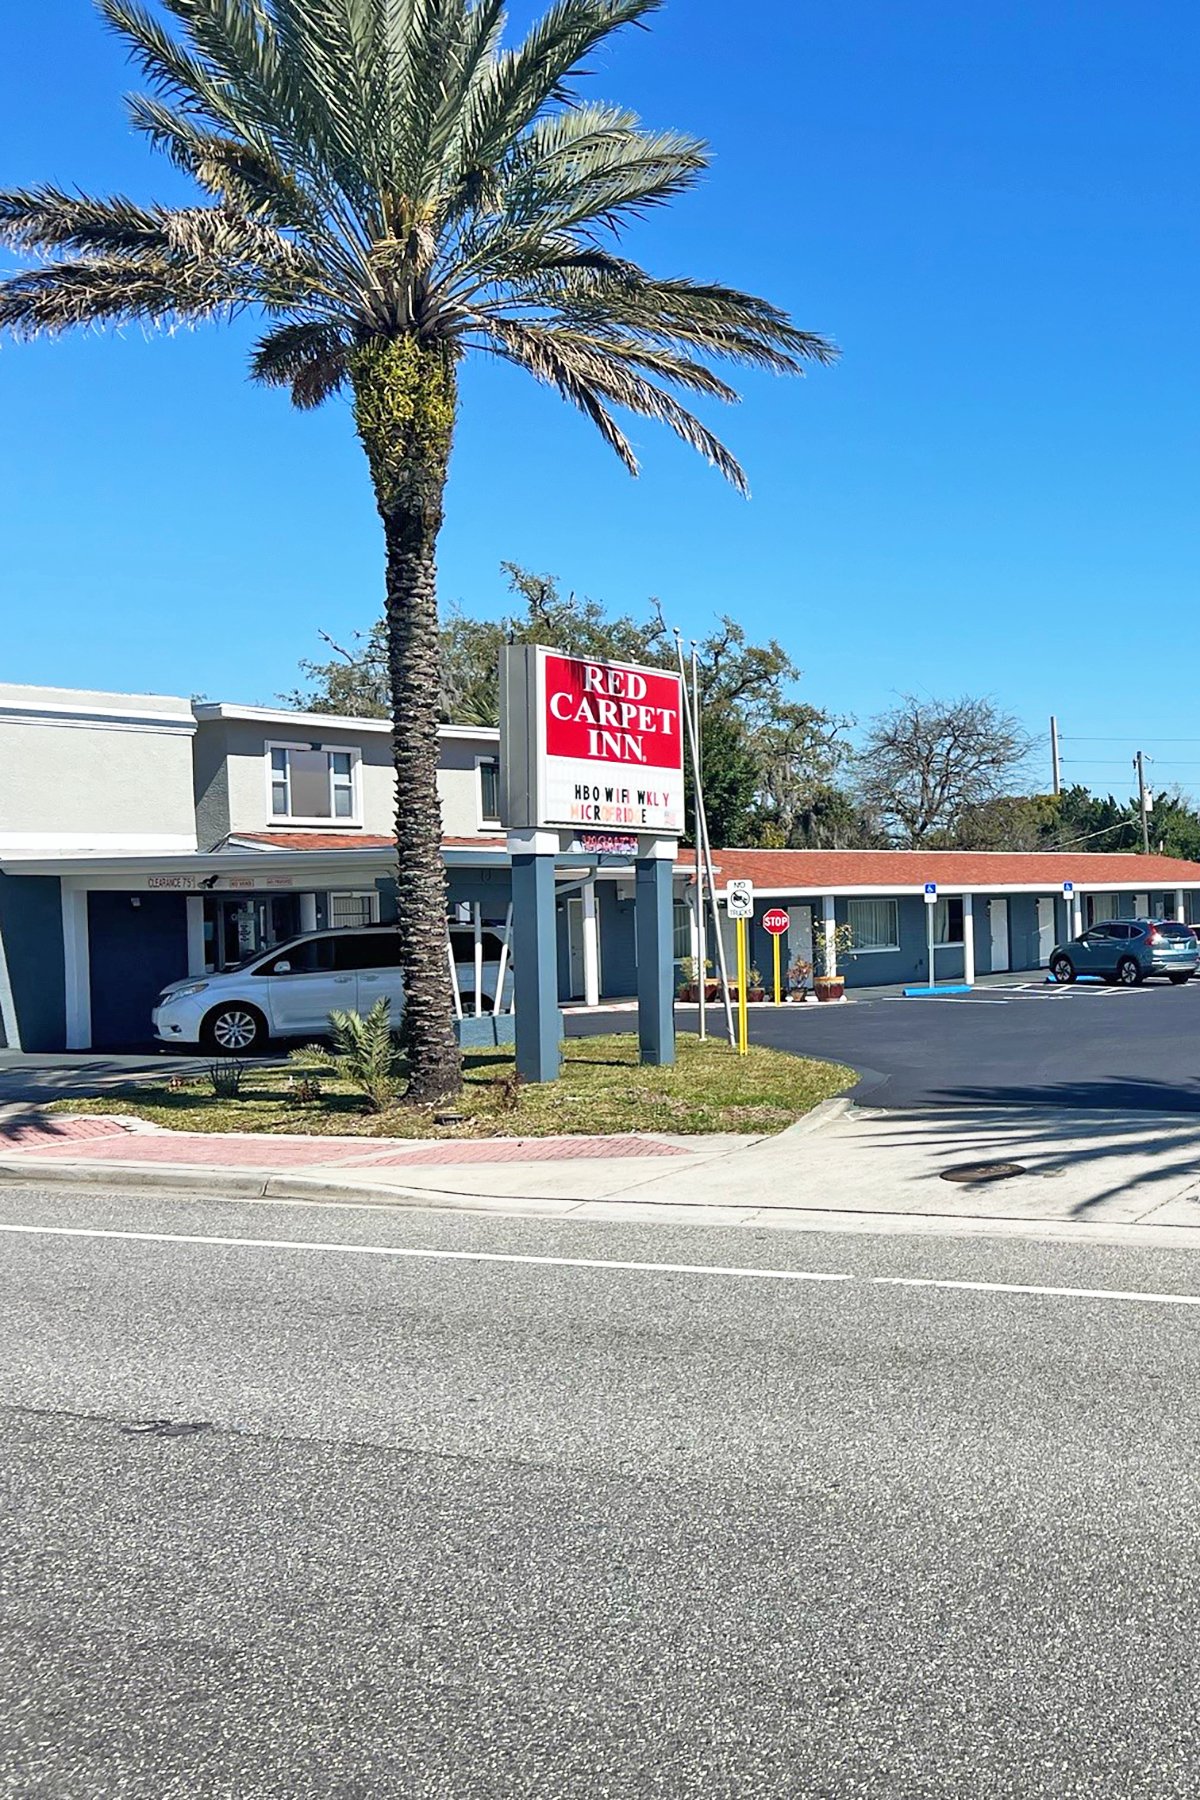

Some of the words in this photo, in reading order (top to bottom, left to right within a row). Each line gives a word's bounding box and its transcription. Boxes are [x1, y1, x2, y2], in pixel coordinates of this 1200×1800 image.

[583, 665, 647, 700] RED
[550, 692, 677, 735] CARPET
[587, 729, 644, 762] INN
[574, 784, 600, 801] HBO
[605, 787, 630, 804] WIFI
[764, 916, 788, 927] STOP
